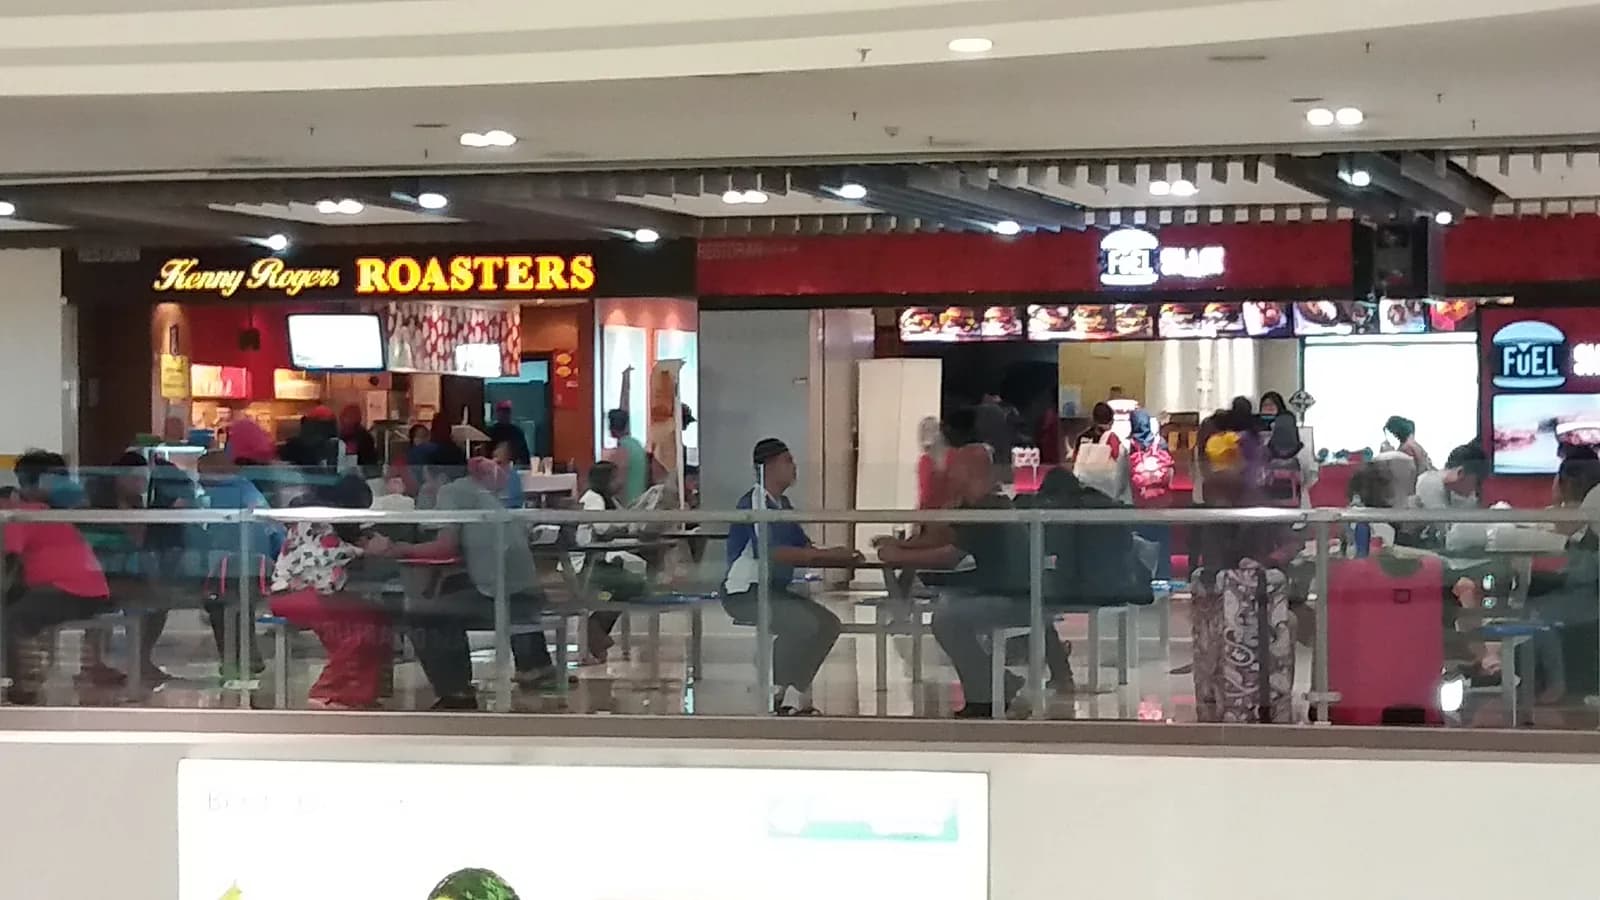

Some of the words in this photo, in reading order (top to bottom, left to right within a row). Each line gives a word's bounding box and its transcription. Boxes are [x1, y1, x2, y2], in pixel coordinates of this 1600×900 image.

[153, 257, 246, 298] Kenny
[246, 256, 340, 297] Rogers
[355, 254, 596, 293] ROASTERS
[1502, 345, 1559, 376] FUEL
